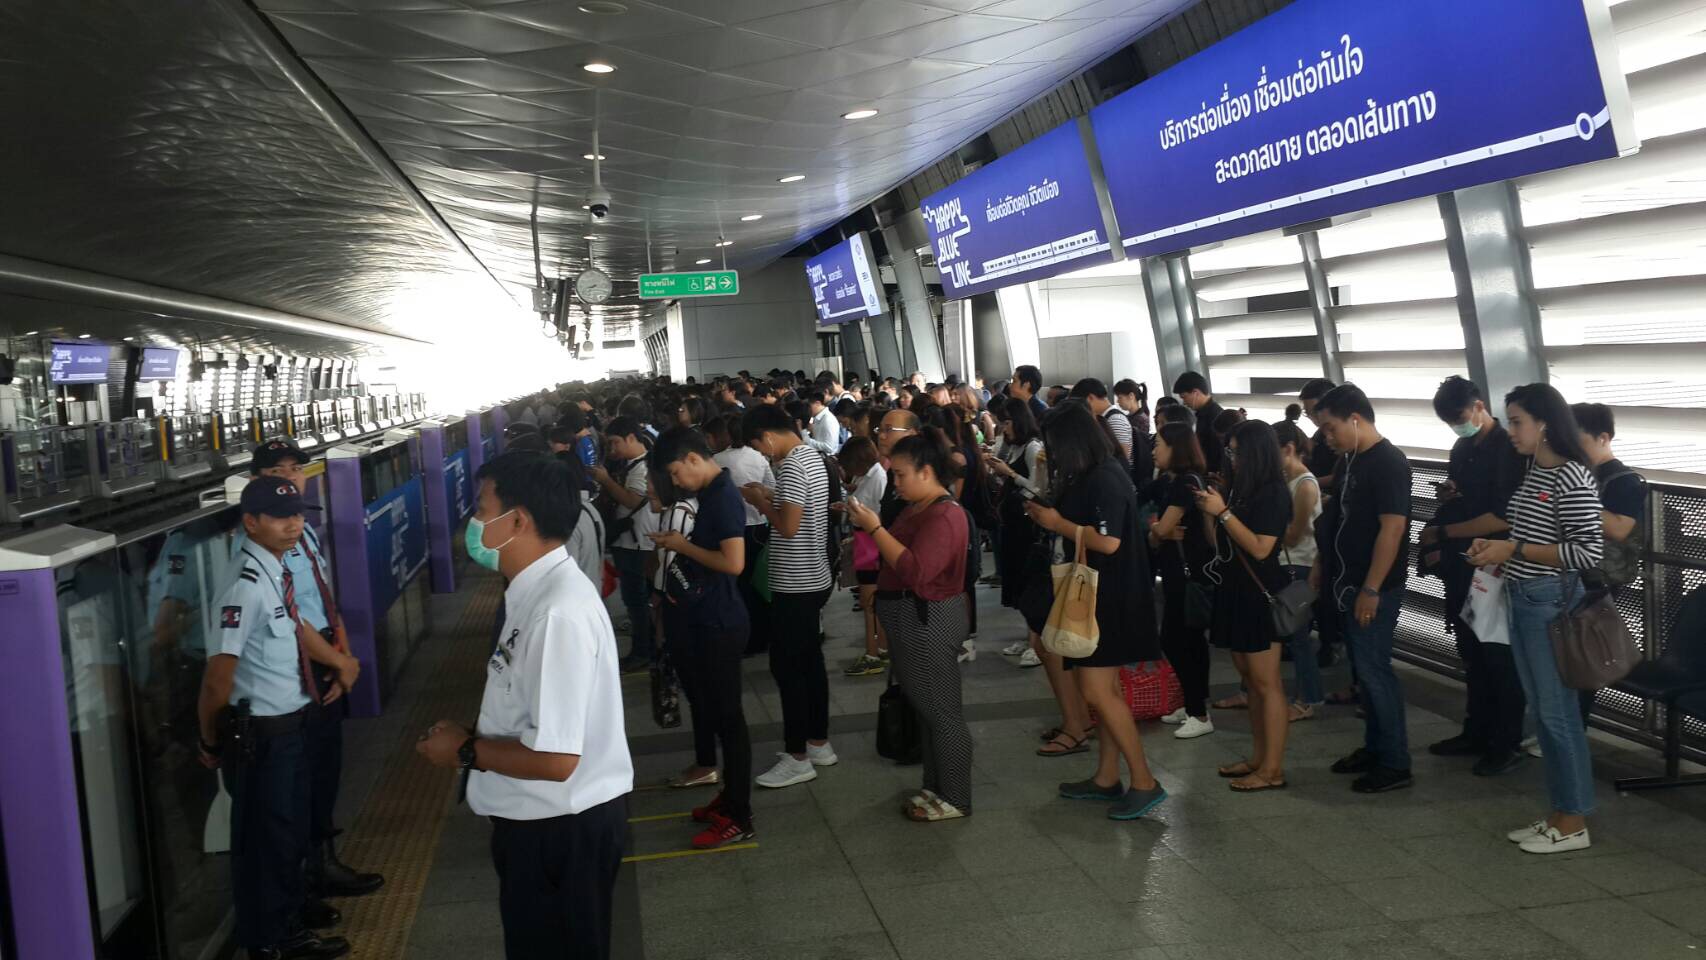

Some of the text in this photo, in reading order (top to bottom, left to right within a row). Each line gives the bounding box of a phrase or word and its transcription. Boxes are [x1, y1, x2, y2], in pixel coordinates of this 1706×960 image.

[1159, 33, 1364, 150] บริการต่อเนื่อง เชื่อมต่อทันใจ
[1215, 90, 1437, 184] สะดวกสบาย ตลอดเส้นทาง
[935, 197, 961, 233] HAPPY
[937, 234, 960, 262] BLUE
[951, 260, 971, 288] LINE
